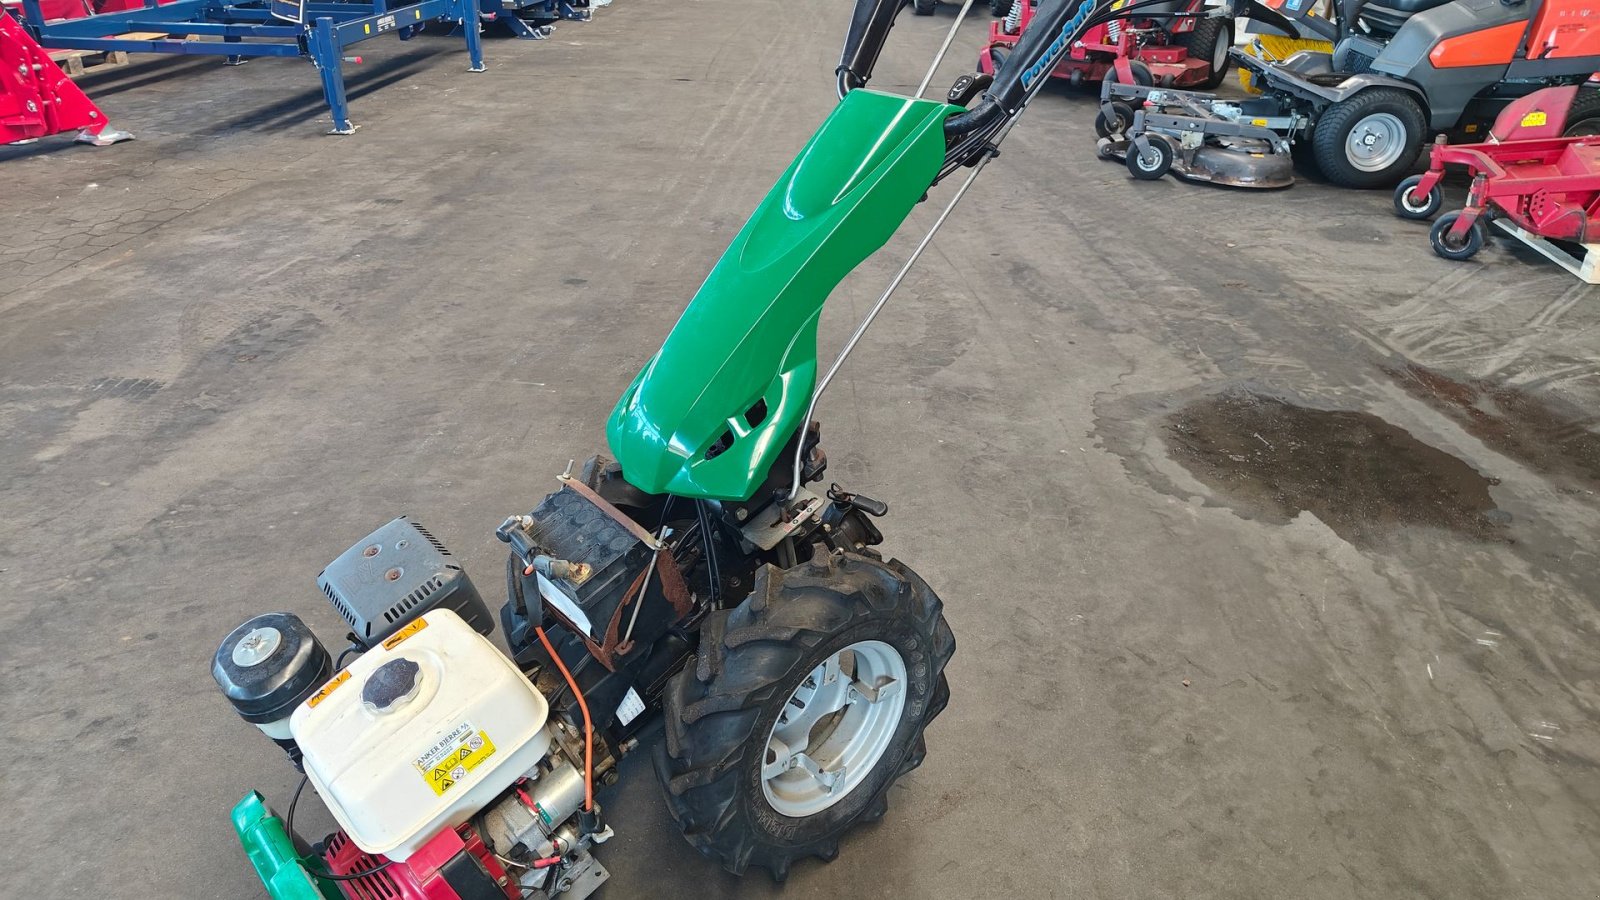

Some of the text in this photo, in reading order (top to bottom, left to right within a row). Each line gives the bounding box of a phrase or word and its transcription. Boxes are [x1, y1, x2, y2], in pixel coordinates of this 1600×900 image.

[1022, 0, 1095, 88] PowerSafe
[417, 745, 441, 766] ANKER
[439, 728, 462, 749] BJERRE
